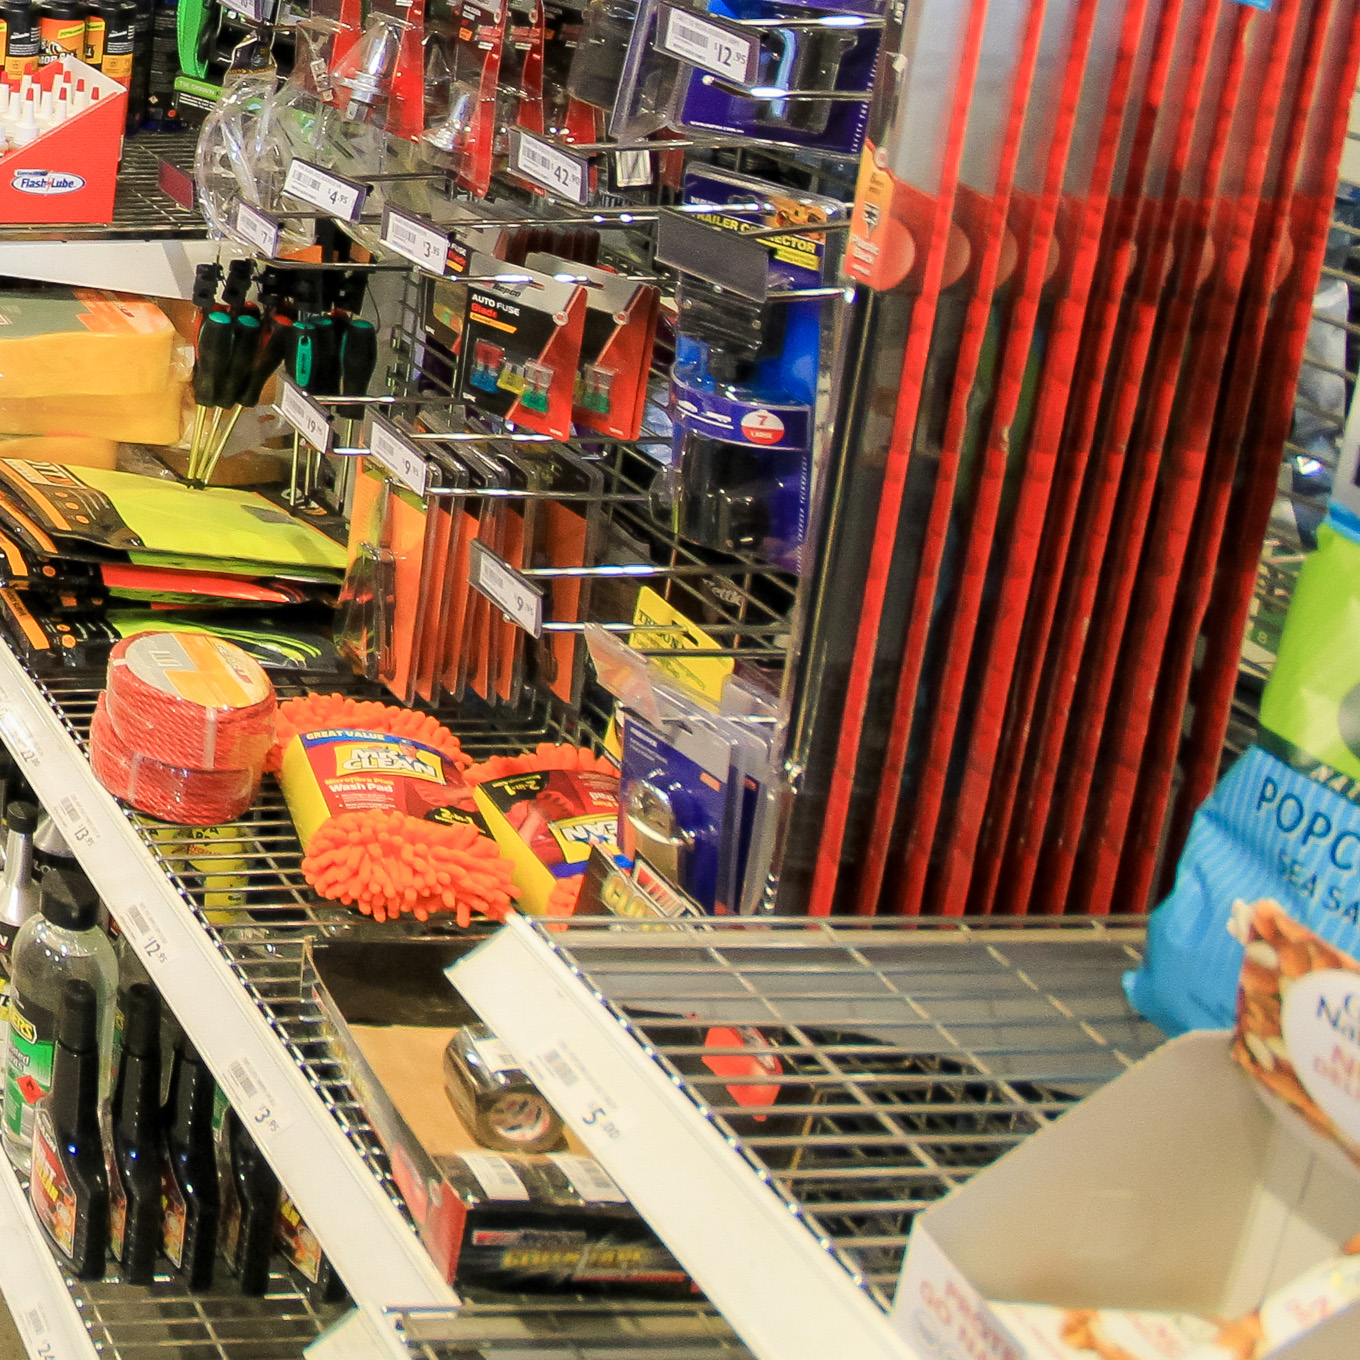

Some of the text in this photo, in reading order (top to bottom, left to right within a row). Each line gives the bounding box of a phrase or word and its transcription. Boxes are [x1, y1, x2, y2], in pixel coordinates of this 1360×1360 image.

[714, 41, 747, 68] $12.95
[21, 177, 75, 189] Flash Lube
[328, 188, 349, 206] $4.95
[422, 241, 441, 259] $3.95
[451, 243, 467, 256] FUSE
[493, 283, 521, 297] Repco
[471, 303, 499, 318] Blade
[472, 294, 520, 316] AUTO FUSE
[757, 414, 769, 427] 7
[750, 430, 773, 440] LARGE
[305, 730, 385, 742] GREAT VALUE
[342, 757, 437, 779] CLEAN
[329, 782, 394, 795] Wash Pad
[1280, 852, 1315, 897] SEA
[142, 938, 167, 963] $12.95
[253, 1103, 280, 1133] $3.95
[580, 1103, 622, 1139] $5.00
